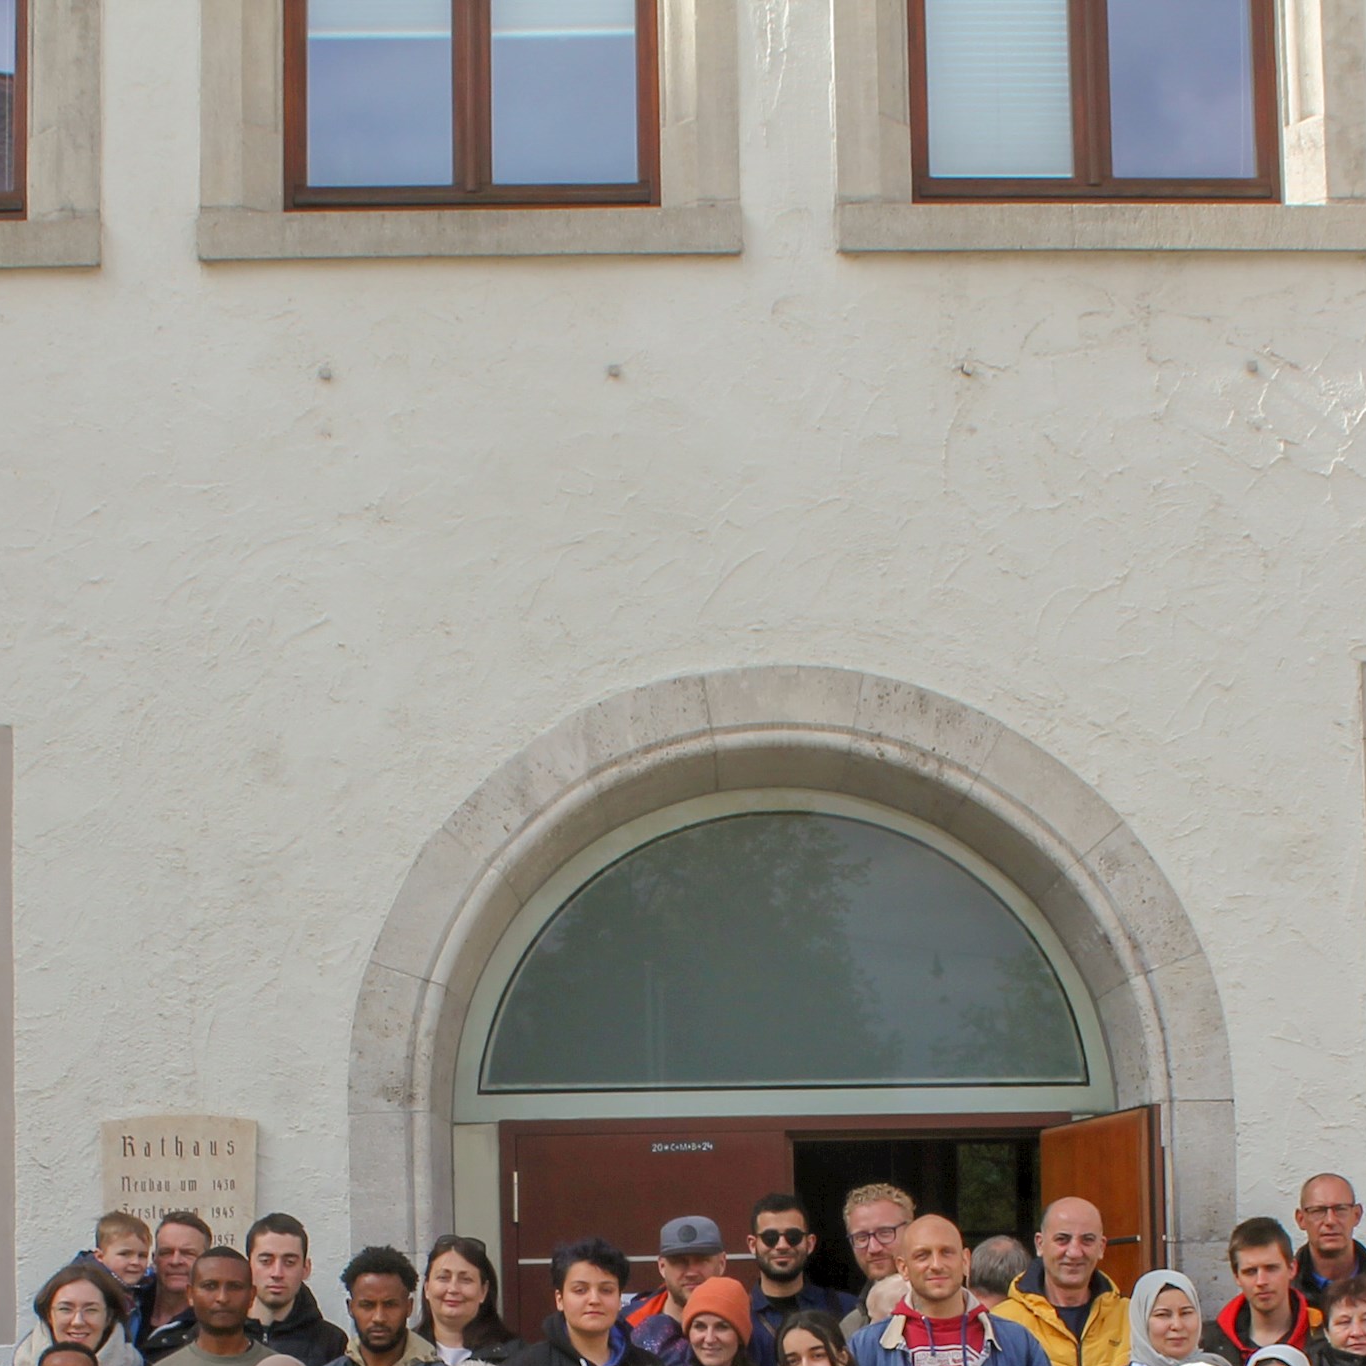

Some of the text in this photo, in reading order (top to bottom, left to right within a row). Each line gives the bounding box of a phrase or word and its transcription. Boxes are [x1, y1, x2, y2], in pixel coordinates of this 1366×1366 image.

[122, 1135, 235, 1158] Rathaus
[121, 1176, 171, 1192] Neubau
[180, 1179, 197, 1192] um
[211, 1206, 235, 1219] 1945
